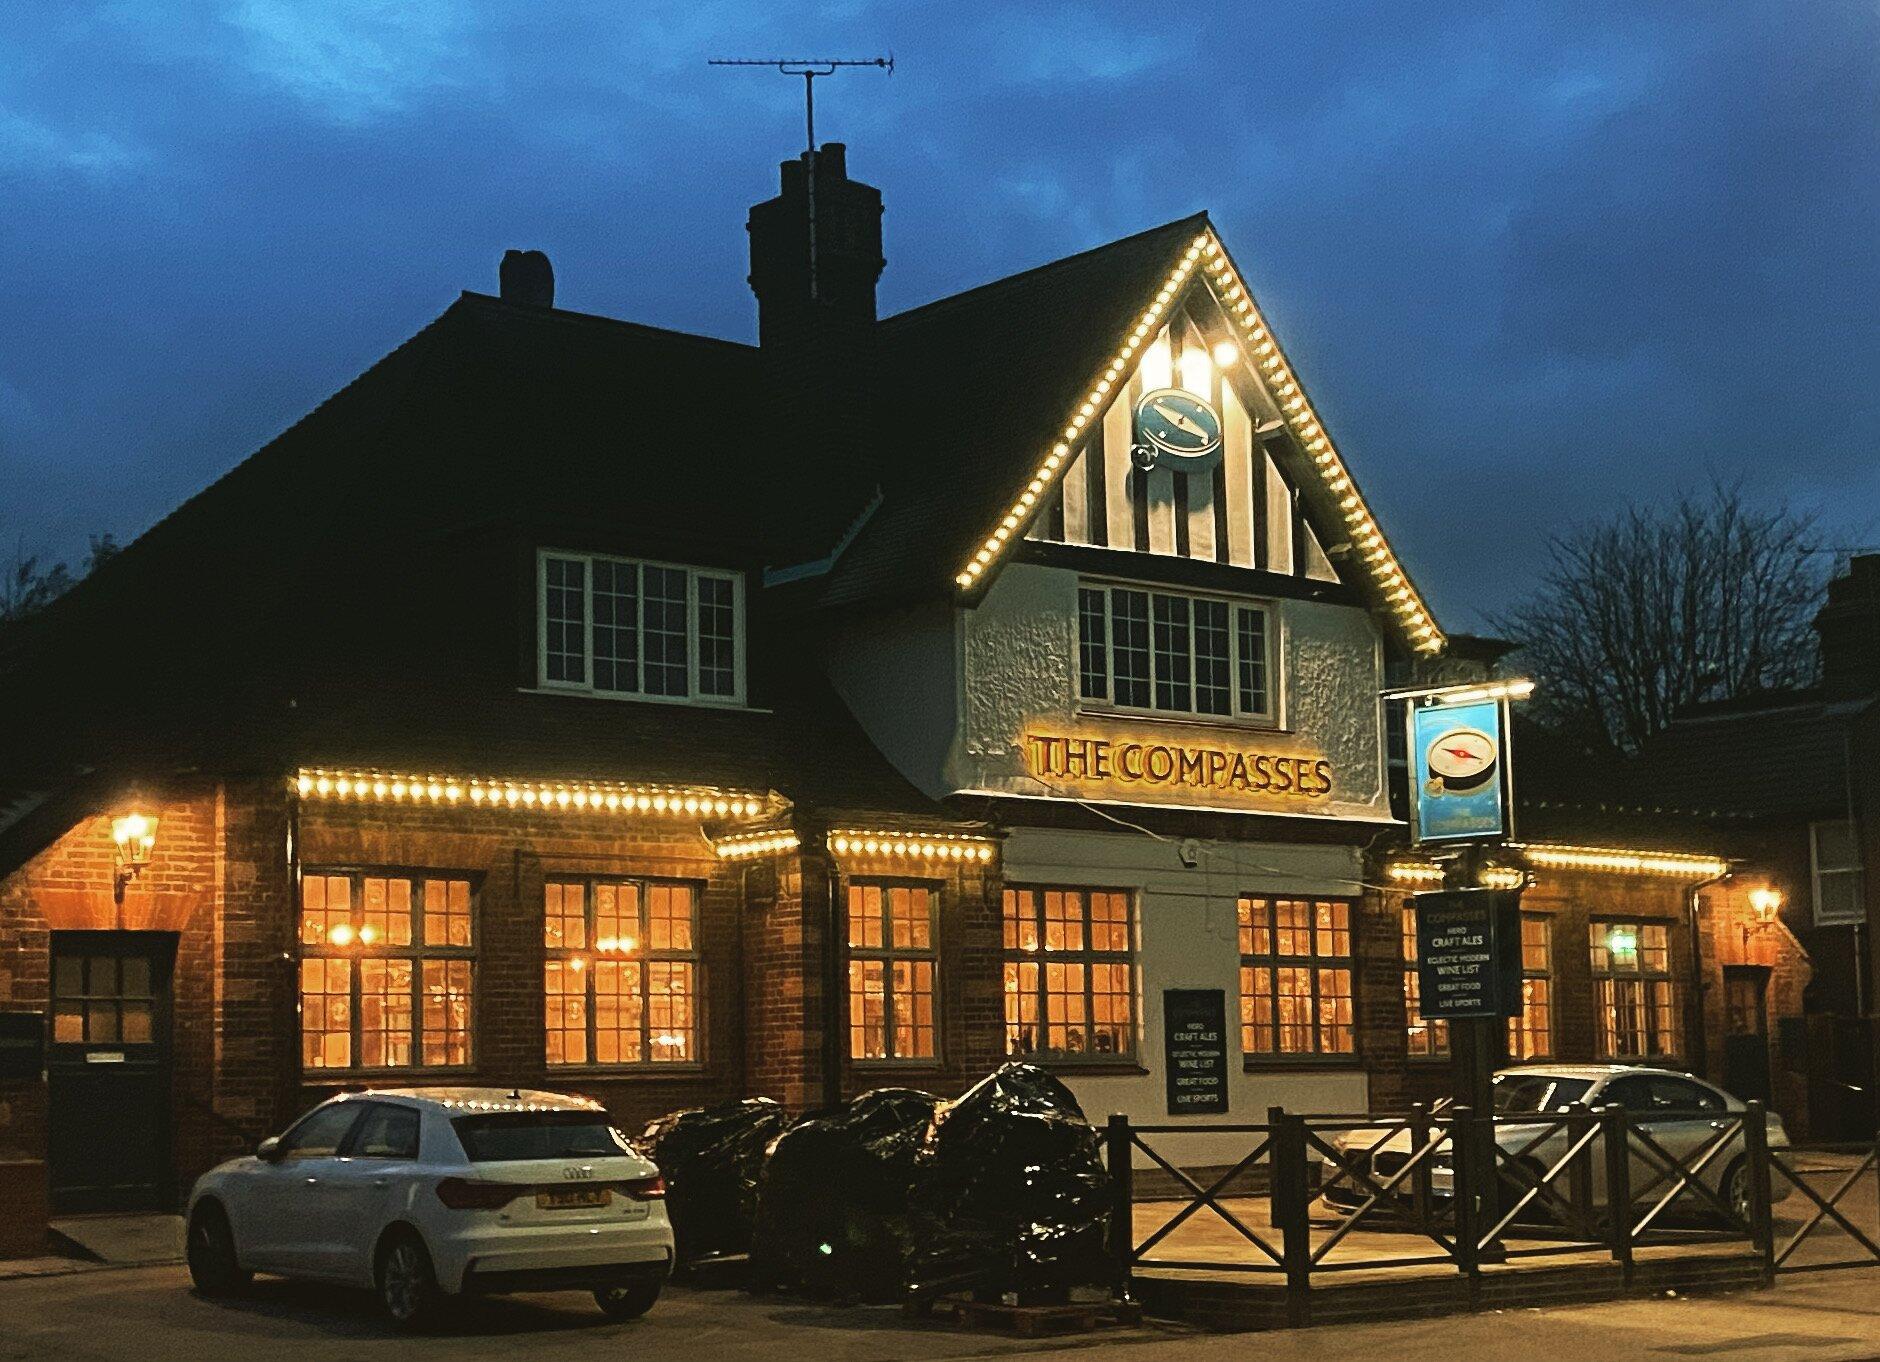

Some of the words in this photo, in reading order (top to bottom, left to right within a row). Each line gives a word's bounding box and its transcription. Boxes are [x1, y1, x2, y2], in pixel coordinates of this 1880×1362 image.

[1027, 734, 1111, 779] THE
[1116, 743, 1332, 795] COMPASSES
[1432, 937, 1459, 947] CRAFT
[1462, 935, 1483, 946] ALES
[1437, 965, 1461, 975] WINE
[1462, 964, 1480, 974] LIST
[1438, 983, 1460, 992] GREAT
[1461, 982, 1481, 990] FOOD
[1439, 1000, 1453, 1008] LIVE
[1455, 999, 1481, 1007] SPORTS
[1174, 1033, 1198, 1041] CRAFT
[1199, 1032, 1218, 1041] ALES
